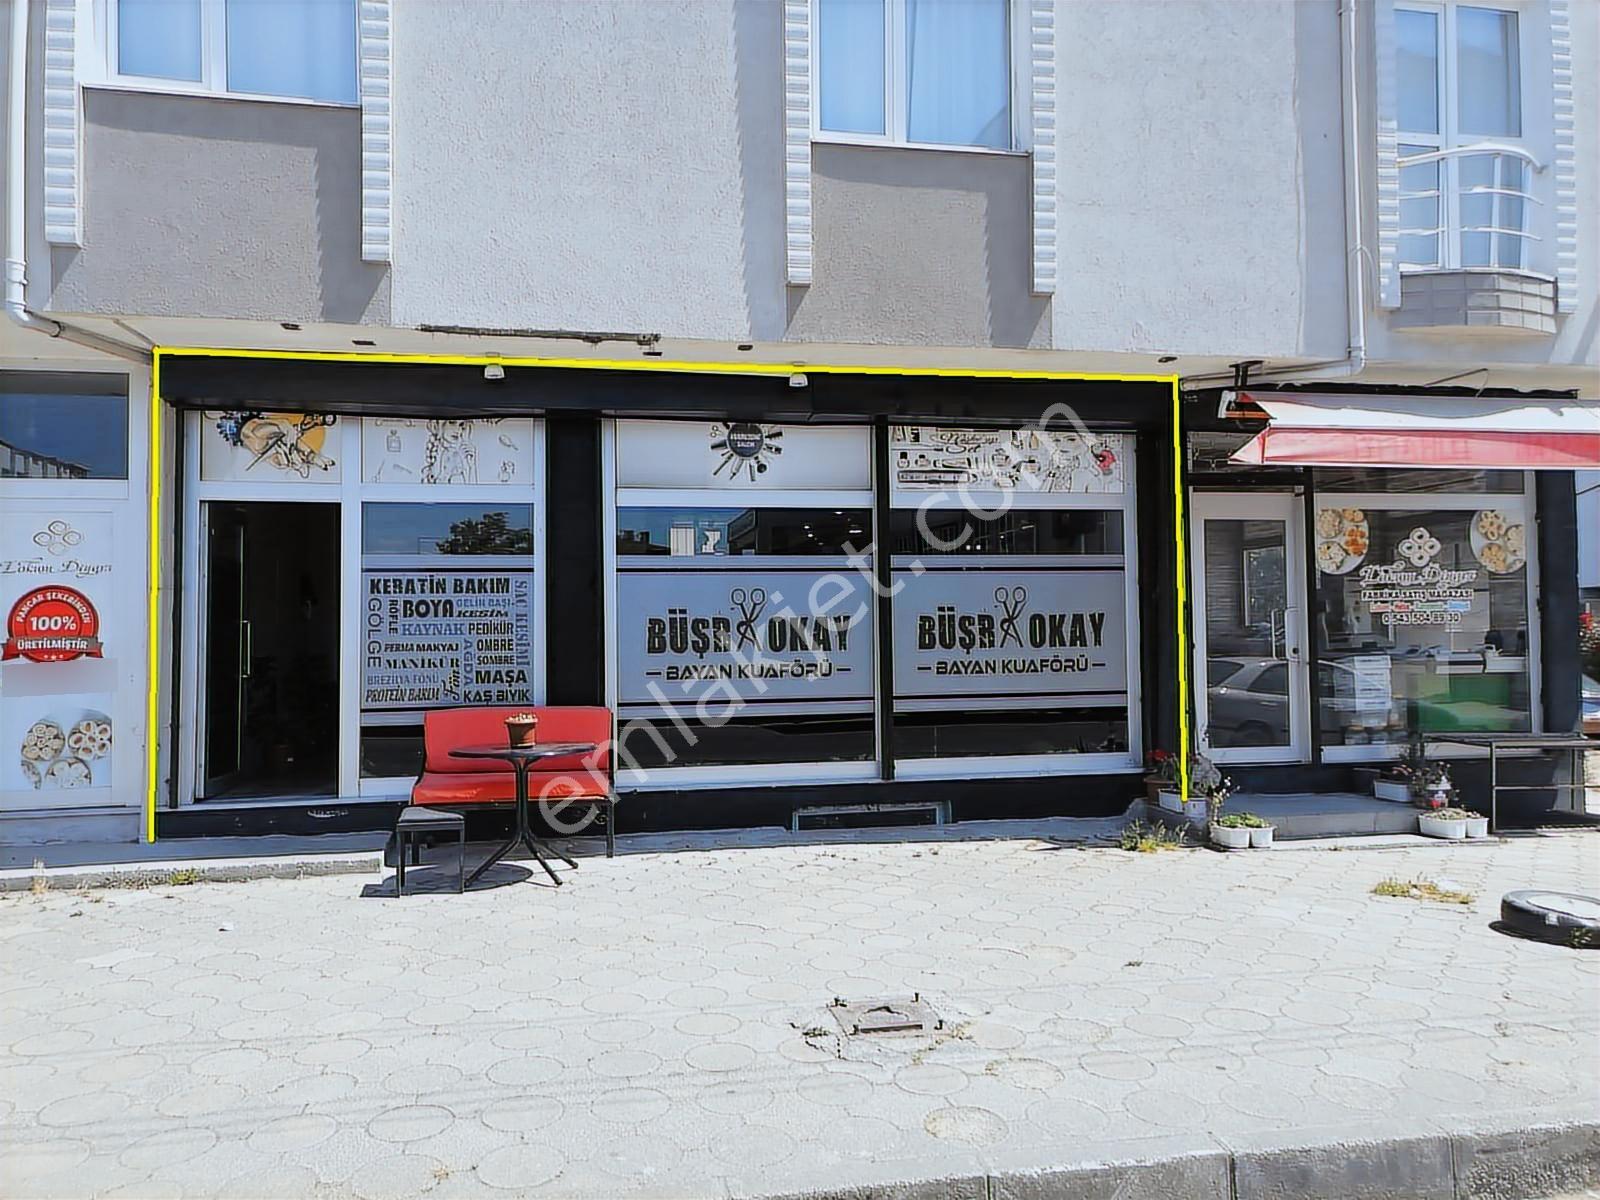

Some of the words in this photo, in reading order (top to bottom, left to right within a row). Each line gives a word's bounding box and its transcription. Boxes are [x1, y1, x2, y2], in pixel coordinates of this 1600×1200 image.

[370, 575, 447, 595] KERATİN
[453, 577, 510, 594] BAKIM
[402, 599, 454, 618] BOYA
[30, 615, 77, 631] 100%
[367, 597, 383, 668] GÖLGE
[401, 623, 465, 636] KAYNAK
[1029, 613, 1105, 648] OKAY
[768, 615, 851, 652] OKAY
[476, 639, 514, 652] OMBRE
[666, 664, 732, 680] BAYAN
[738, 658, 833, 679] KUAFÖRÜ
[936, 661, 996, 675] BAYAN
[1002, 654, 1088, 674] KUAFÖRÜ
[475, 669, 528, 687] MAŞA
[464, 690, 494, 705] KAŞ
